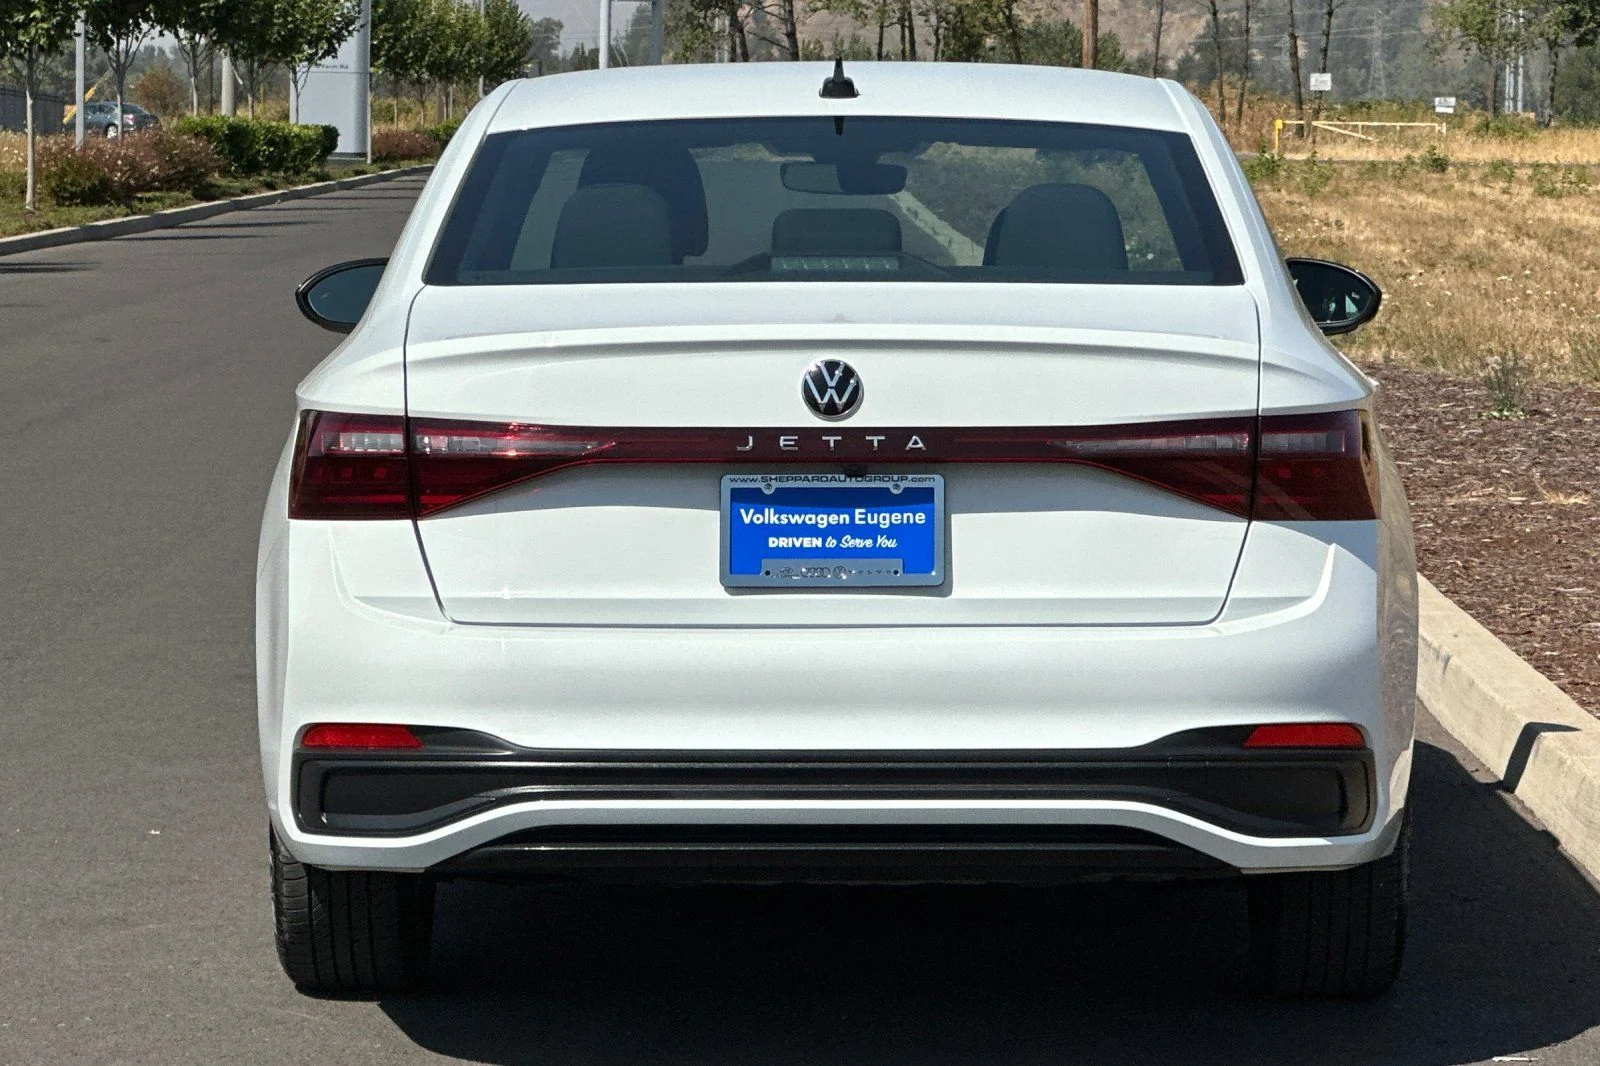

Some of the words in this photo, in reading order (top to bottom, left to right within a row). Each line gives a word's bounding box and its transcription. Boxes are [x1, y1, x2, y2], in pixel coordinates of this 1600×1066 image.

[736, 435, 927, 450] JETTA
[729, 475, 935, 483] www.SHEPPARDAUTOGROUP.com
[740, 508, 850, 528] Volkswagen
[855, 508, 926, 528] Eugene
[768, 537, 822, 548] DRIVEN
[825, 536, 837, 548] to
[840, 535, 873, 548] Serve
[876, 535, 898, 548] You
